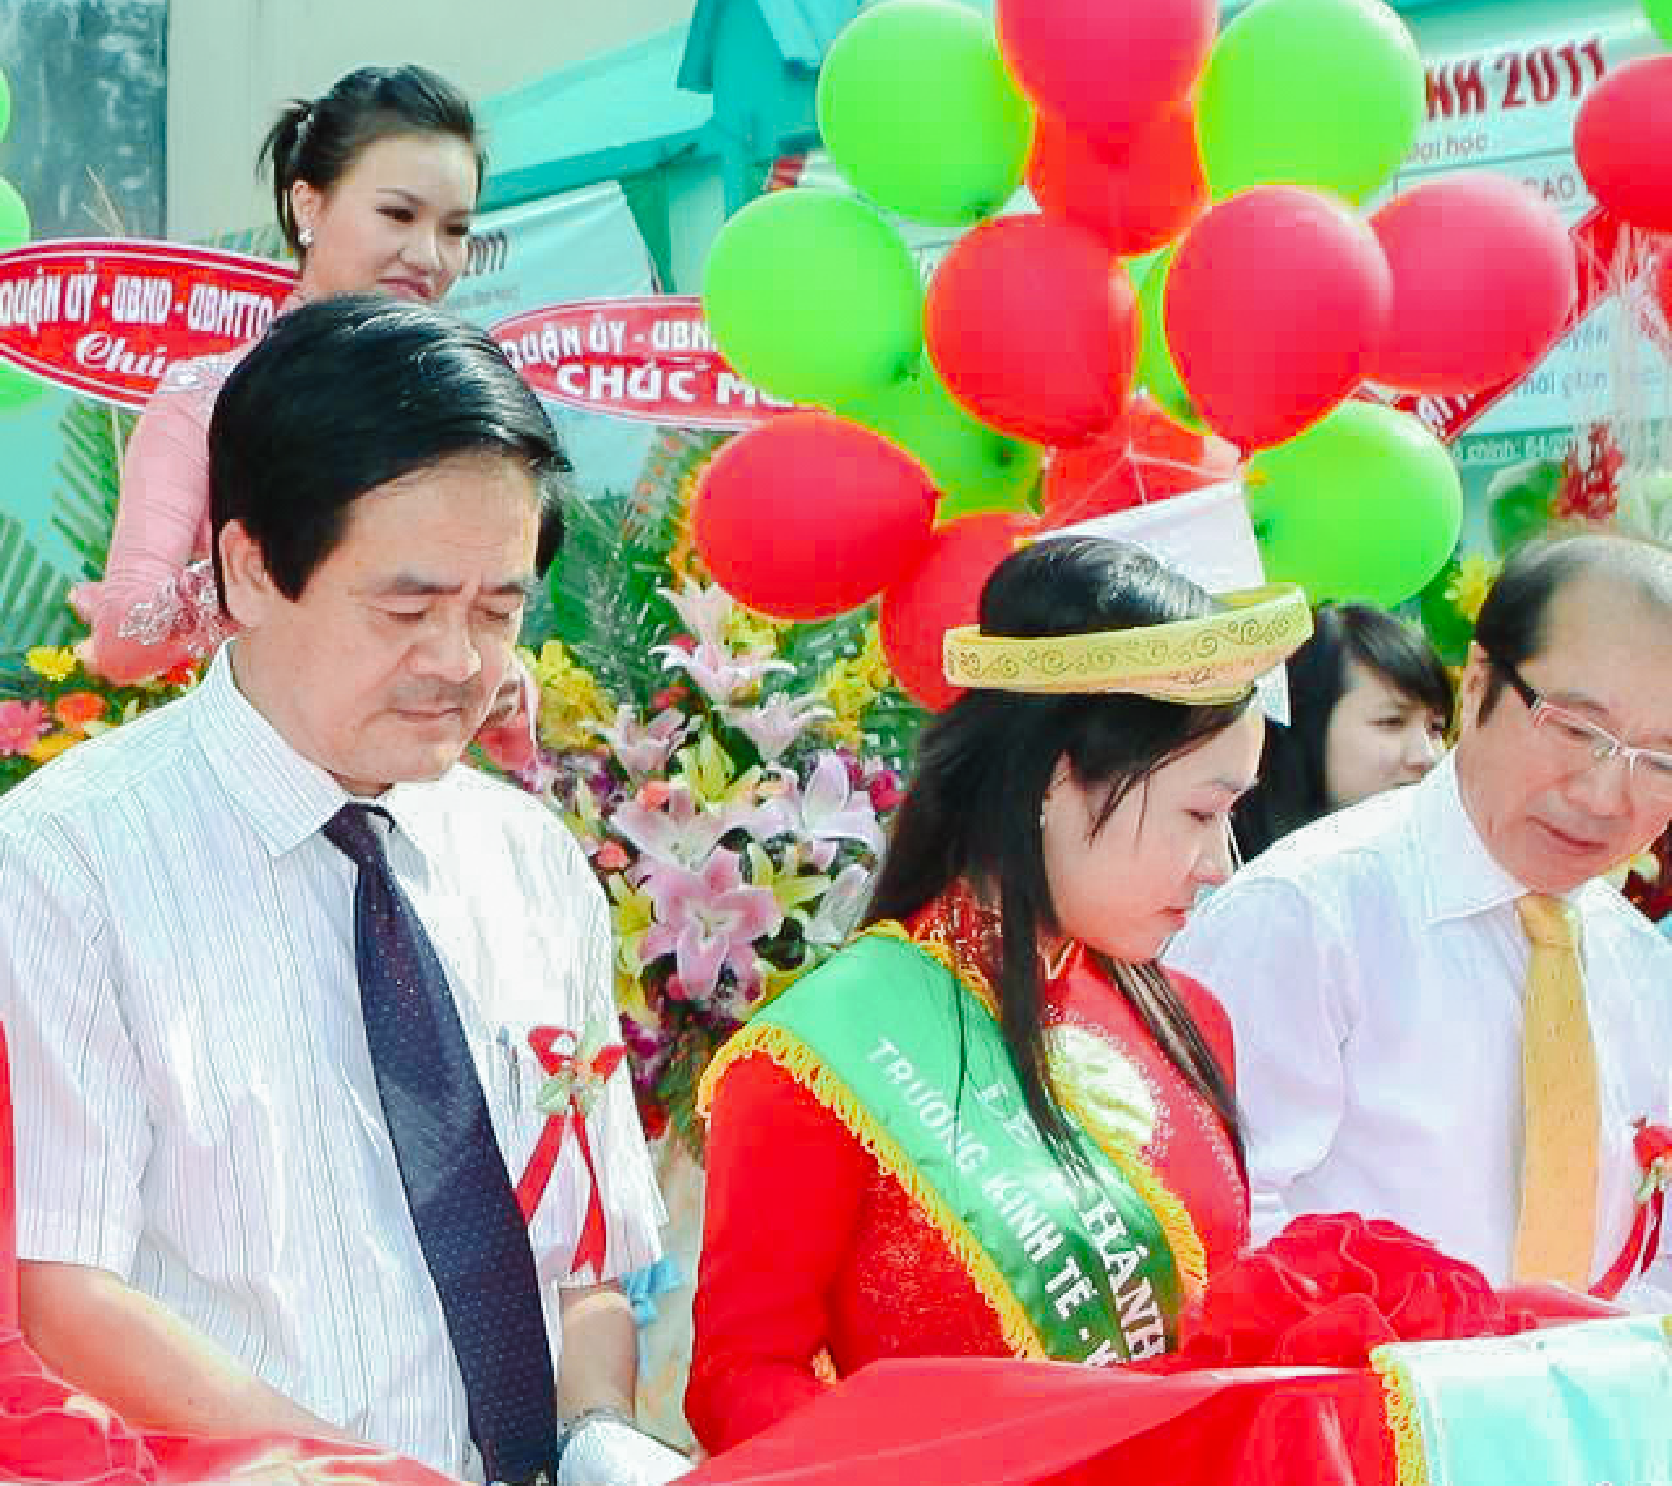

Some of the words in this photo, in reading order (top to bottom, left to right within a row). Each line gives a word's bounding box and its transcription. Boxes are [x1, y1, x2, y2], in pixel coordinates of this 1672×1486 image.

[1494, 33, 1606, 110] 2011
[557, 359, 697, 402] CHÚC
[983, 1174, 1064, 1263] KINH
